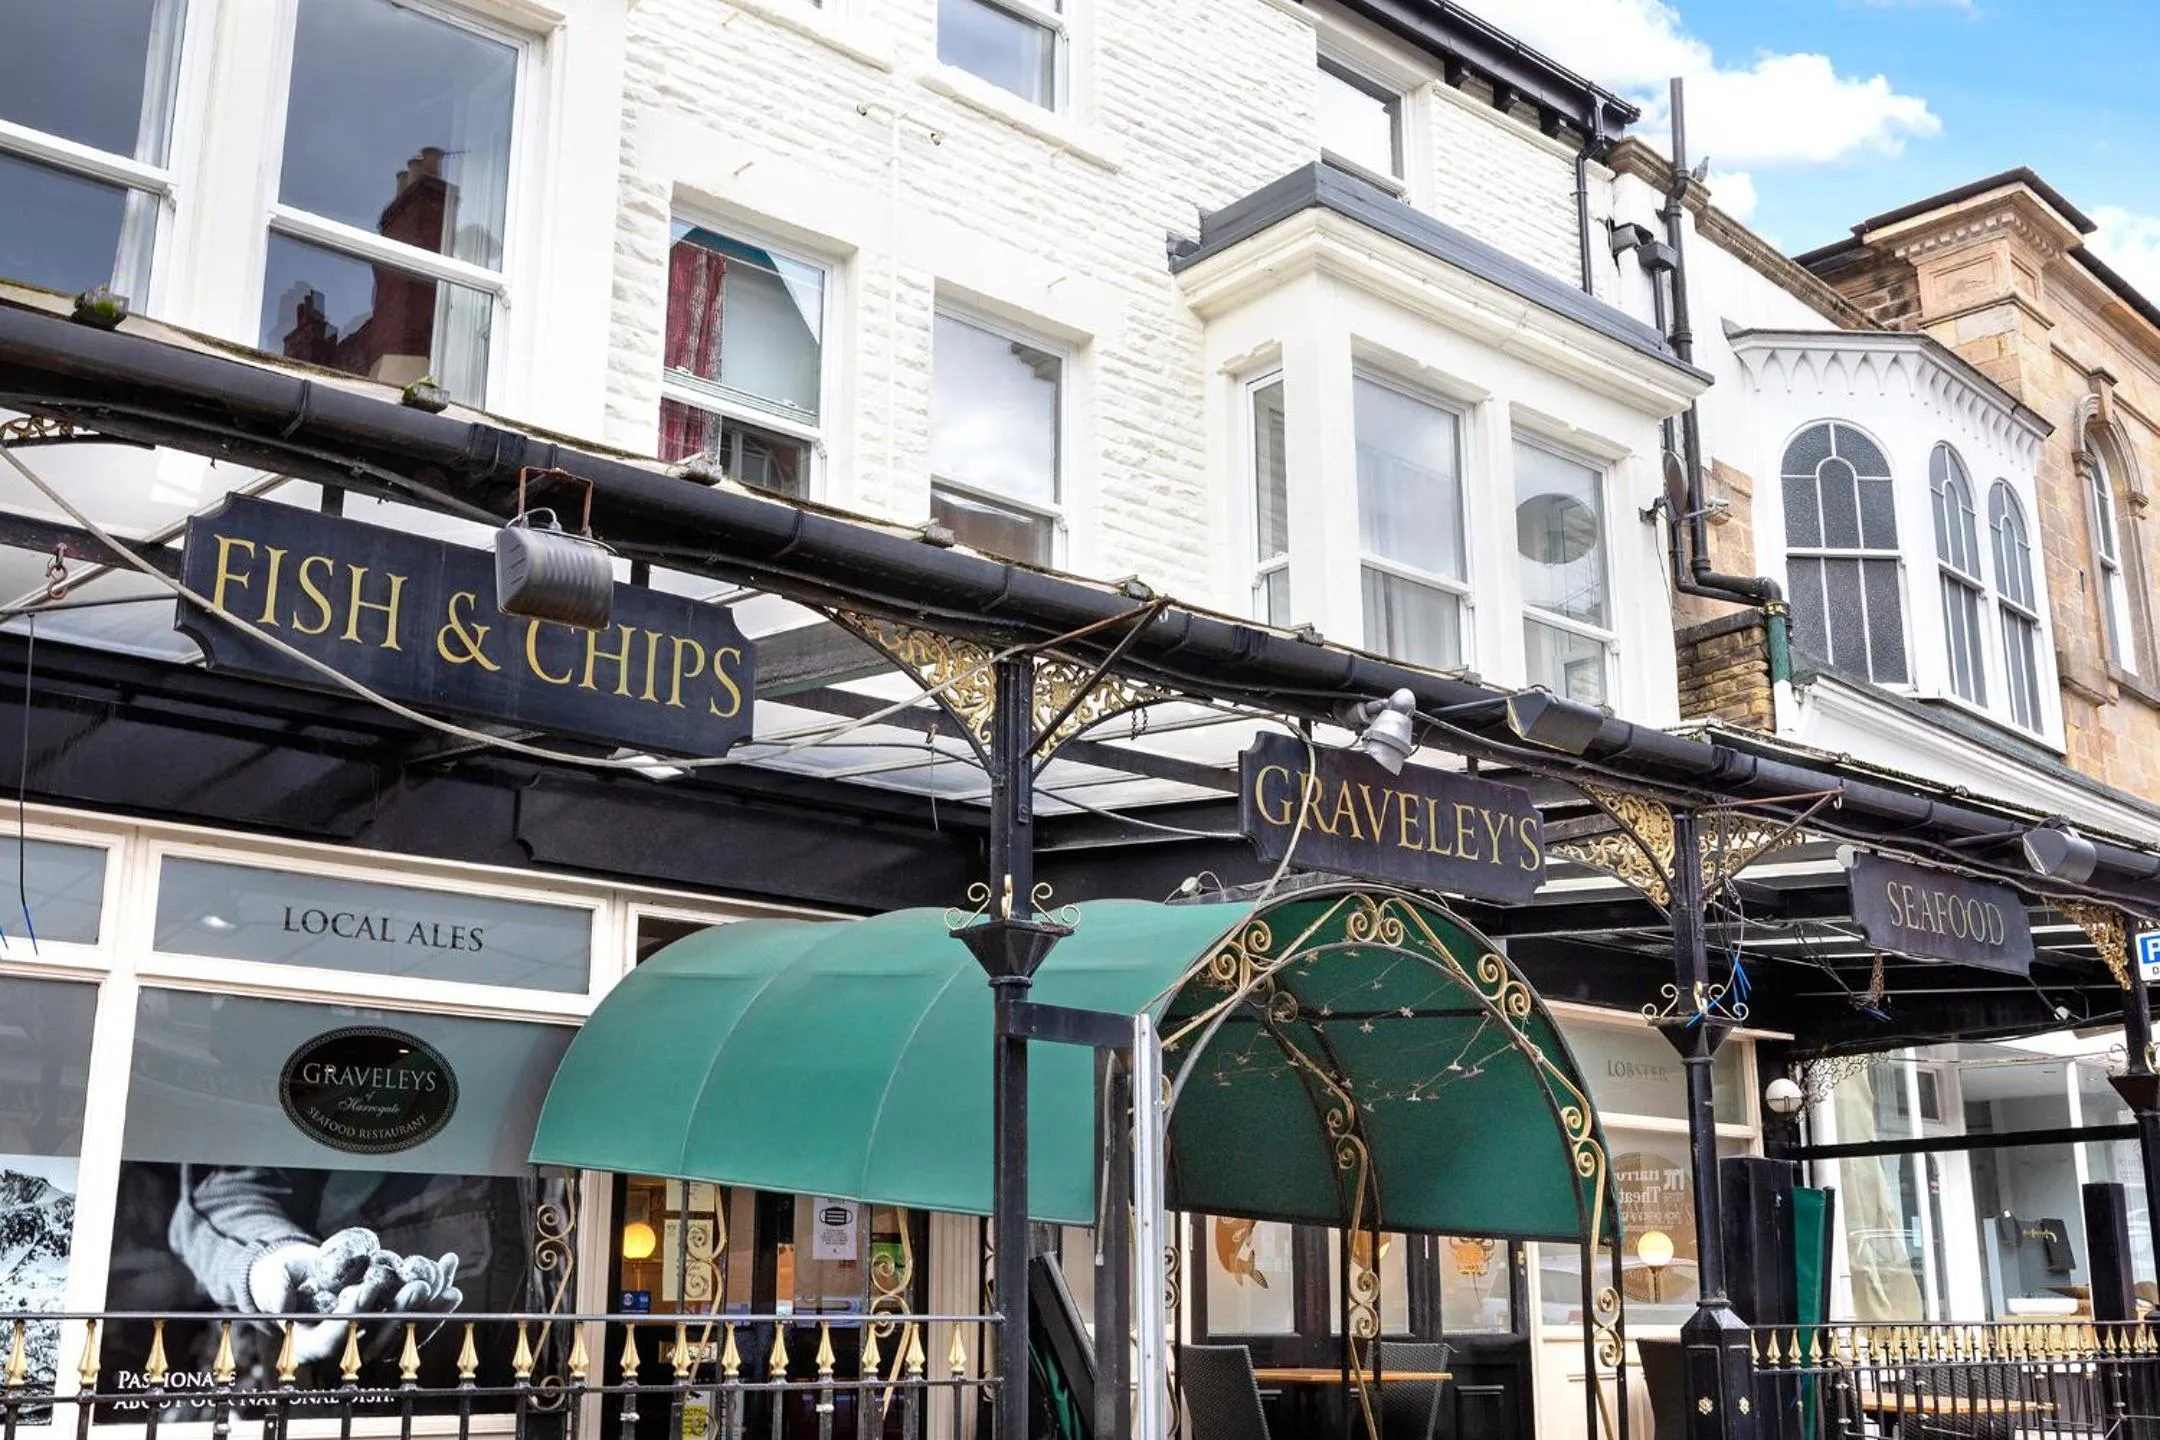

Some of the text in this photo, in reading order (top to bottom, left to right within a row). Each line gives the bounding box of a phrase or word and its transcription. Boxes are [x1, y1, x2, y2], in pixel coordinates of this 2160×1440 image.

[210, 534, 741, 718] FISH & CHIPS
[1255, 765, 1540, 871] GRAVELEY'S
[1887, 880, 2004, 945] SEAFOOD
[282, 906, 484, 952] LOCAL ALES
[303, 1062, 436, 1091] GRAVELEYS
[1607, 1060, 1668, 1081] LOBSTER
[308, 1106, 428, 1139] SEAFOOD RESTAURANT
[338, 1097, 400, 1118] Harrogate
[117, 1370, 237, 1389] PASIONAE
[240, 1388, 340, 1406] NATONAL
